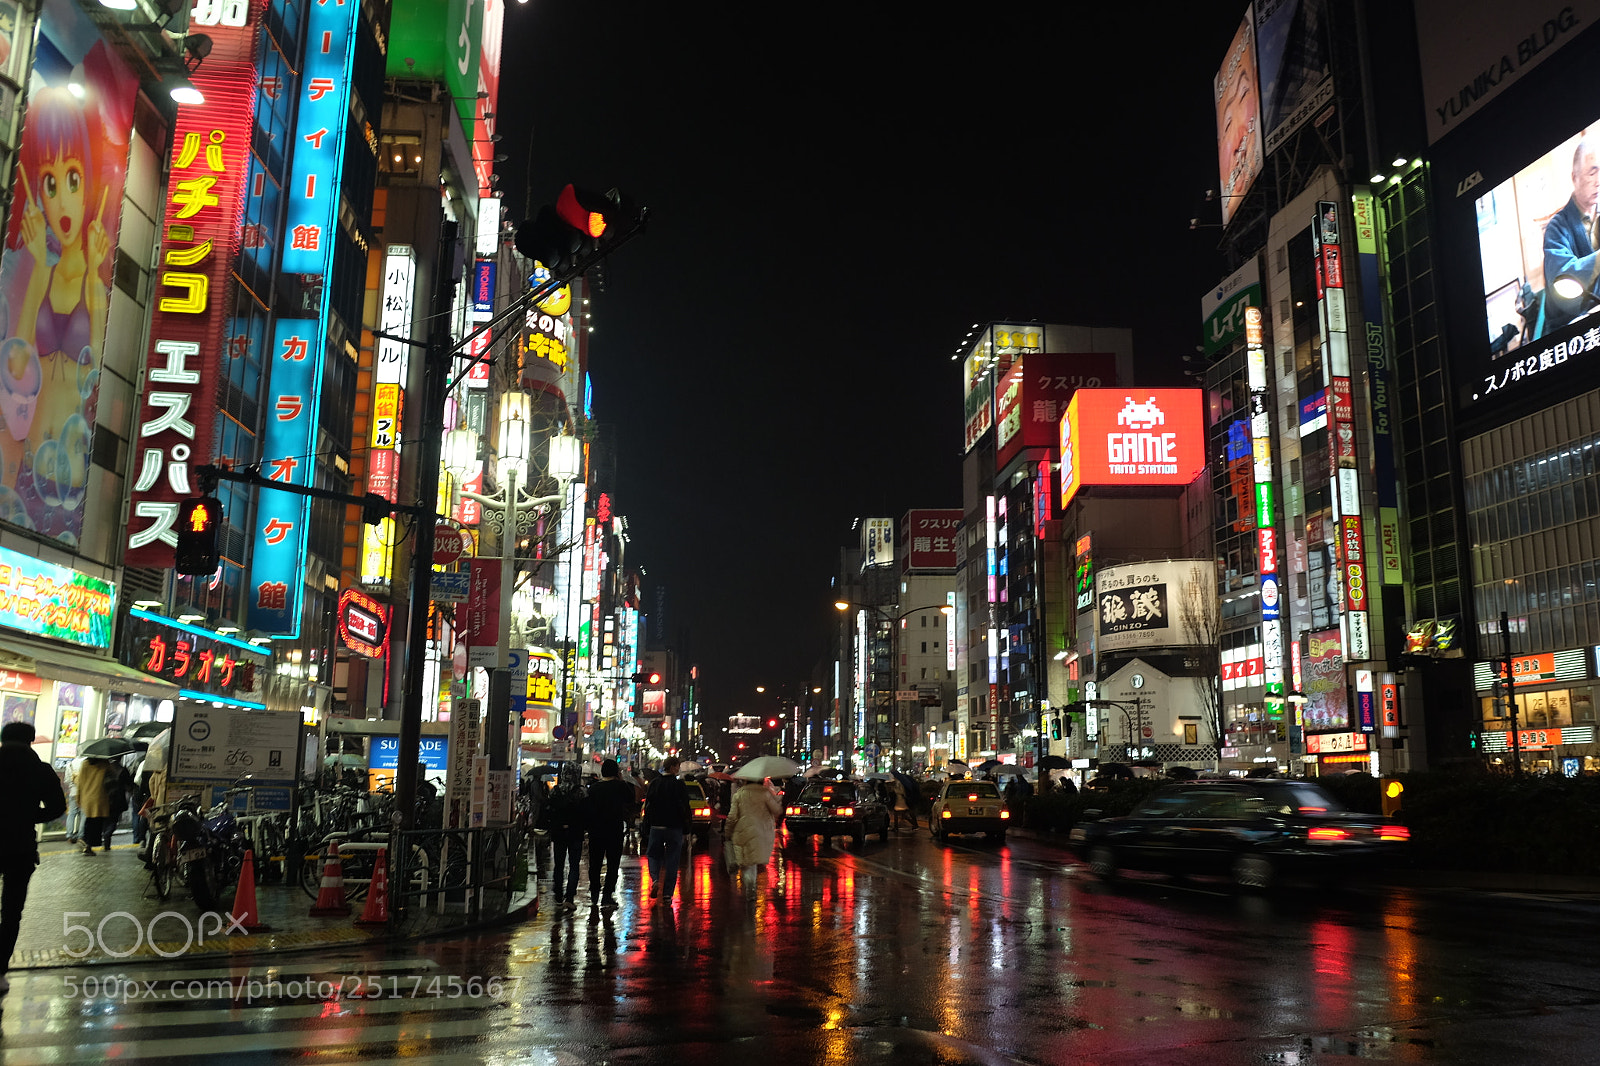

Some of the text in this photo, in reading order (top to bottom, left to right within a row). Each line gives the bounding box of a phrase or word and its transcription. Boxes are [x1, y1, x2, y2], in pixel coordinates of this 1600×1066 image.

[1436, 56, 1515, 126] YUNIKA
[291, 0, 346, 252] ーティー館
[480, 266, 491, 302] PROMISE
[1108, 434, 1178, 467] GAME
[257, 336, 309, 612] カラオケ館
[1109, 468, 1178, 479] TAITO STATION
[148, 634, 236, 688] カラオケ
[1363, 694, 1372, 724] PROMISE
